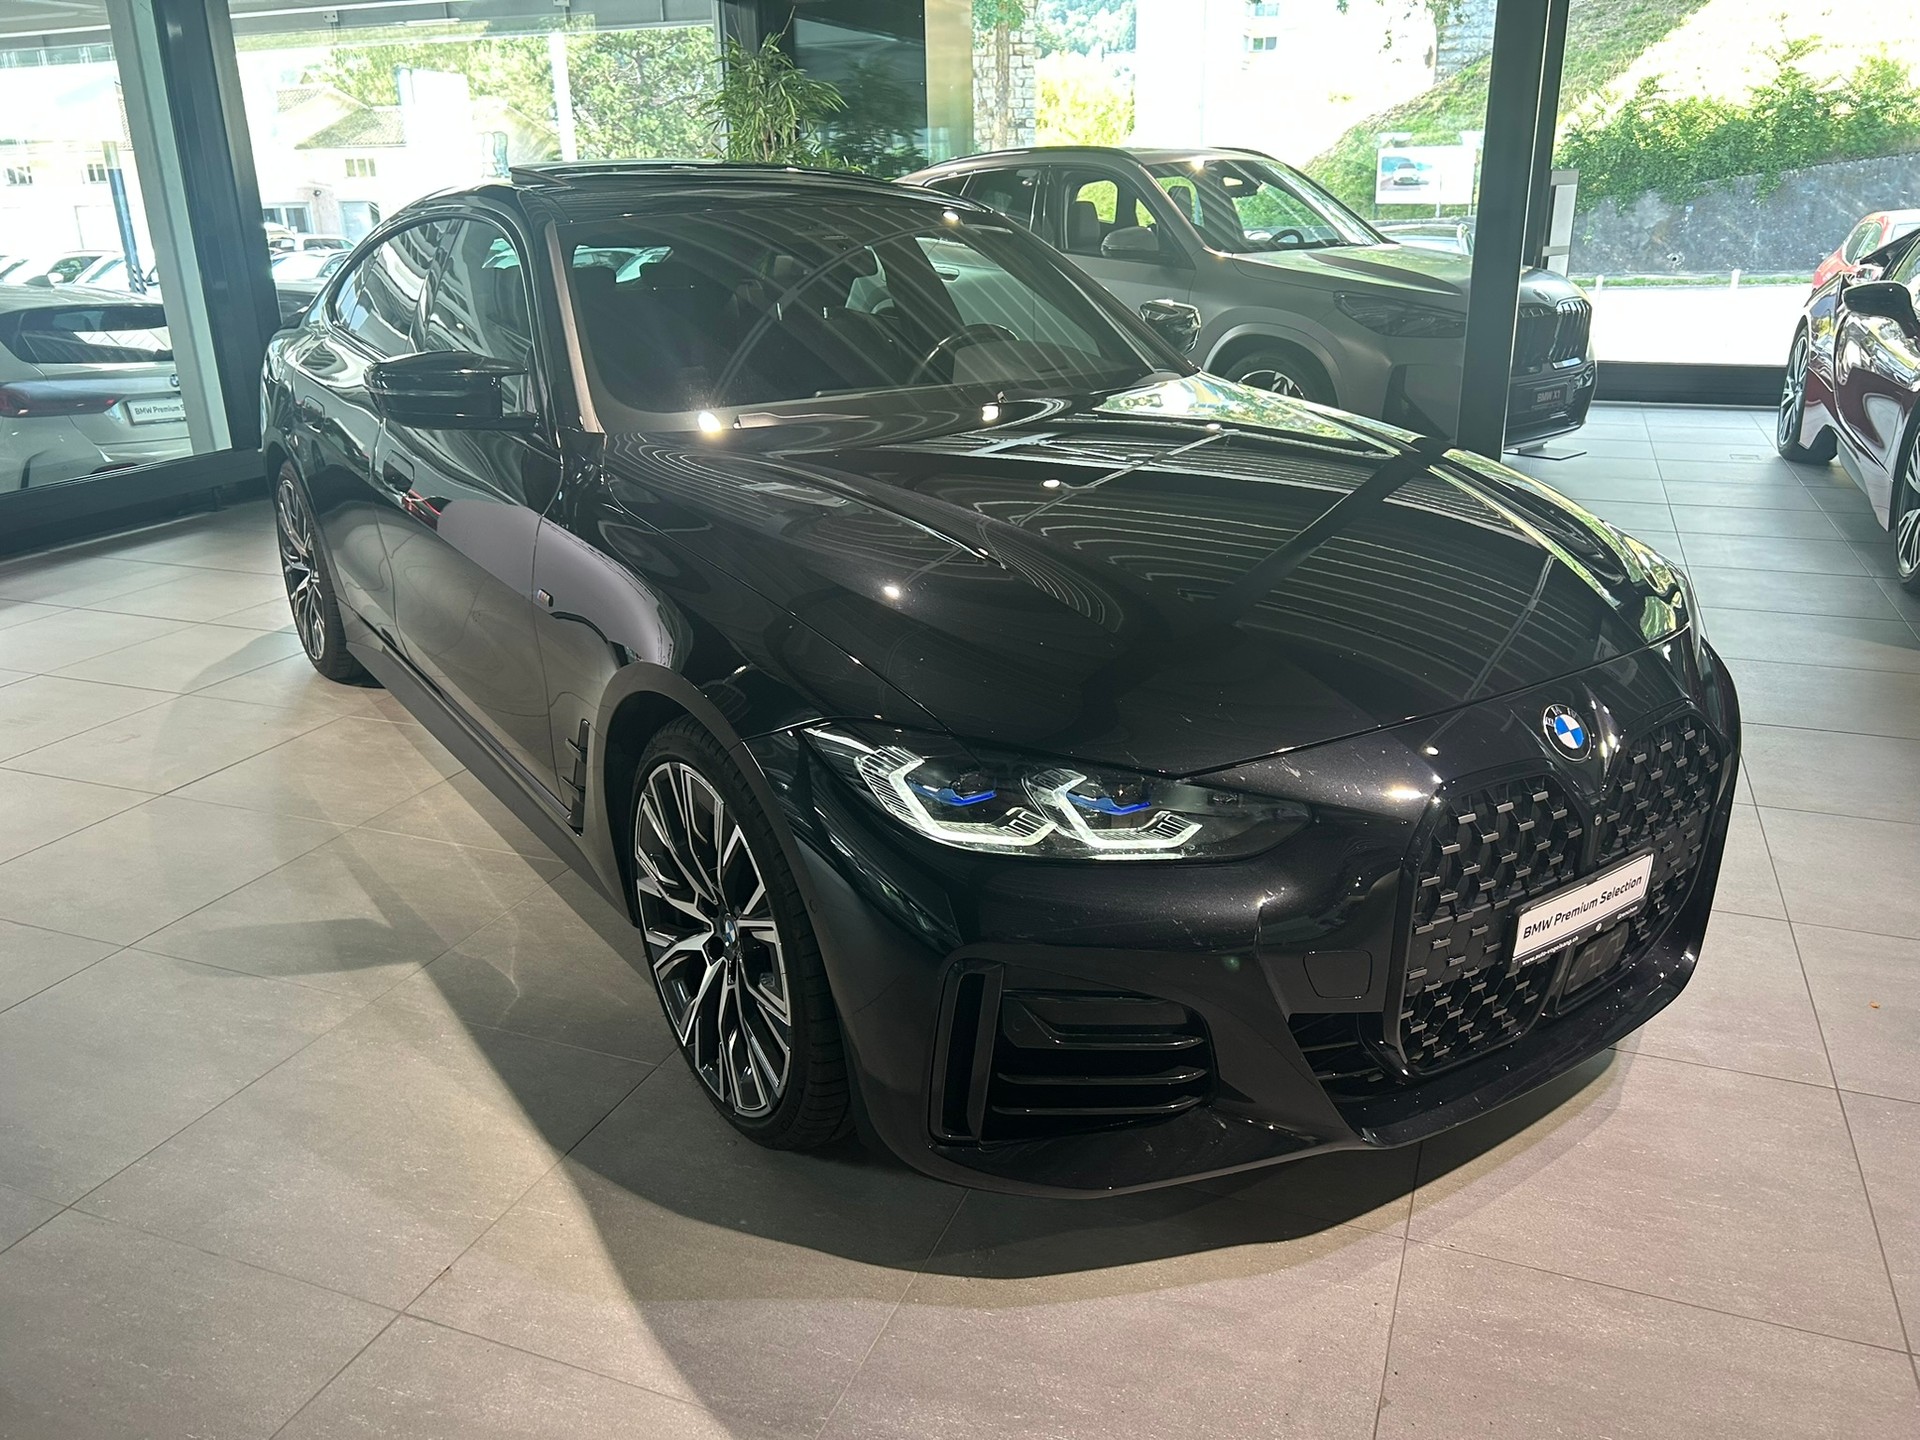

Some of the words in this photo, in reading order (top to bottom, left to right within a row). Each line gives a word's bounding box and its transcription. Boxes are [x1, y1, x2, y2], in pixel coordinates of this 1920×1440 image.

[134, 406, 152, 415] BMW
[153, 404, 180, 414] Premium
[1523, 915, 1553, 939] BMW
[1554, 897, 1598, 926] Premium
[1600, 876, 1642, 904] Selection
